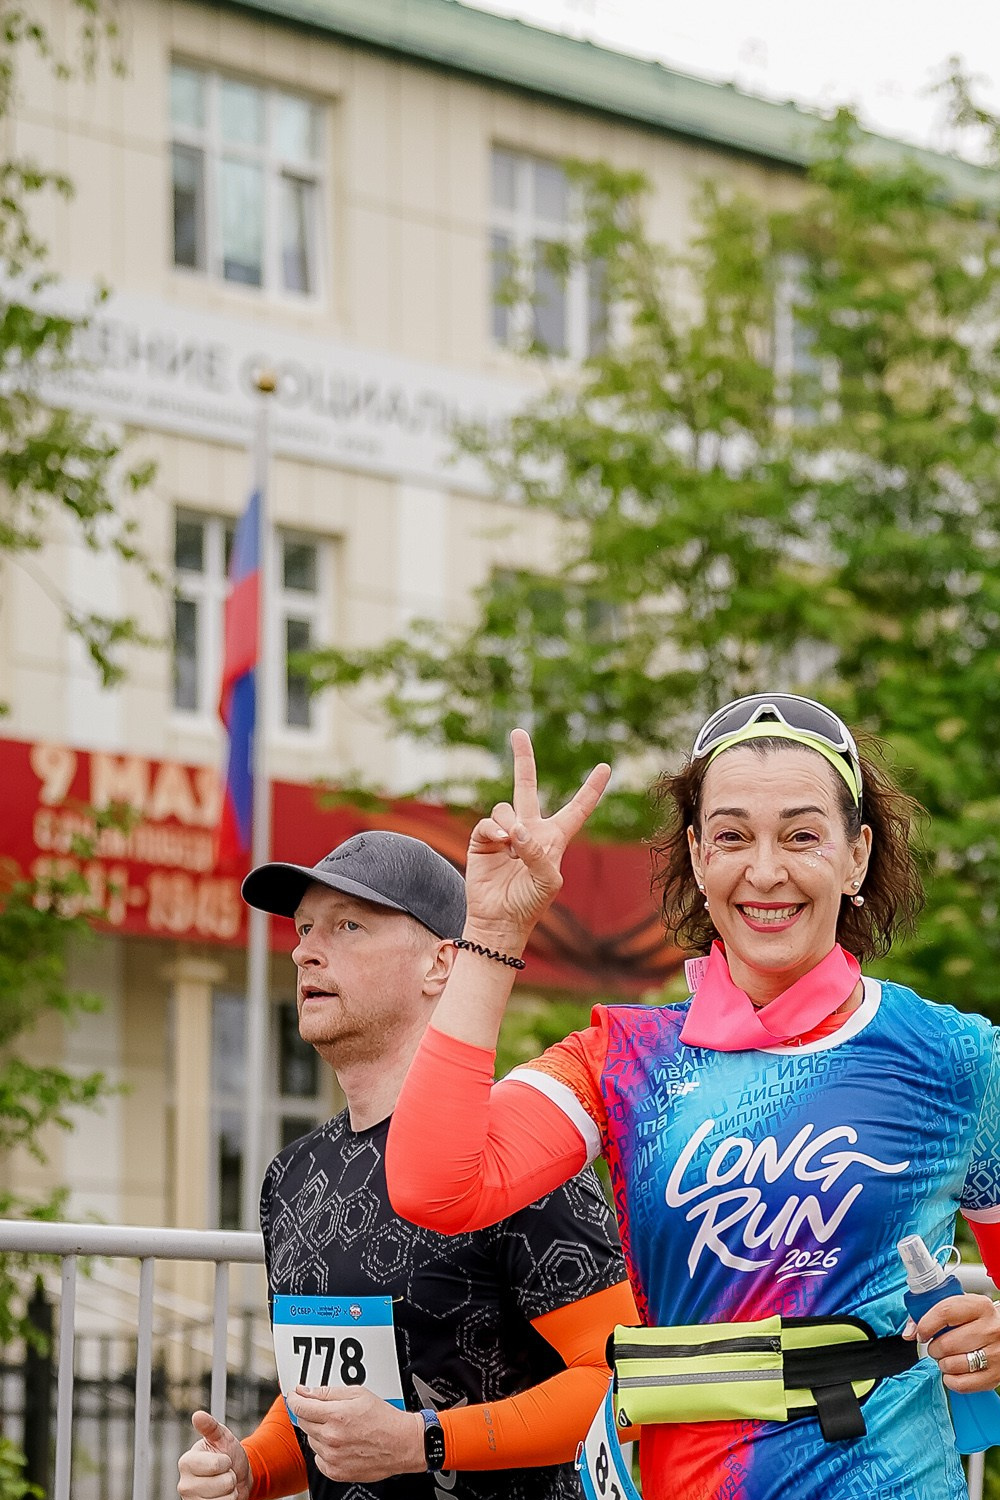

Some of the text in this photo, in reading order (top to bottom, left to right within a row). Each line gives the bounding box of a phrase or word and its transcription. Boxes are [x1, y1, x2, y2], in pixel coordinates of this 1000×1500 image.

[954, 1058, 979, 1077] бег
[666, 1119, 910, 1209] LONG
[970, 1157, 996, 1174] бег
[635, 1176, 656, 1199] бег
[685, 1183, 864, 1279] RUN
[776, 1246, 841, 1276] 2026
[293, 1336, 367, 1386] 778
